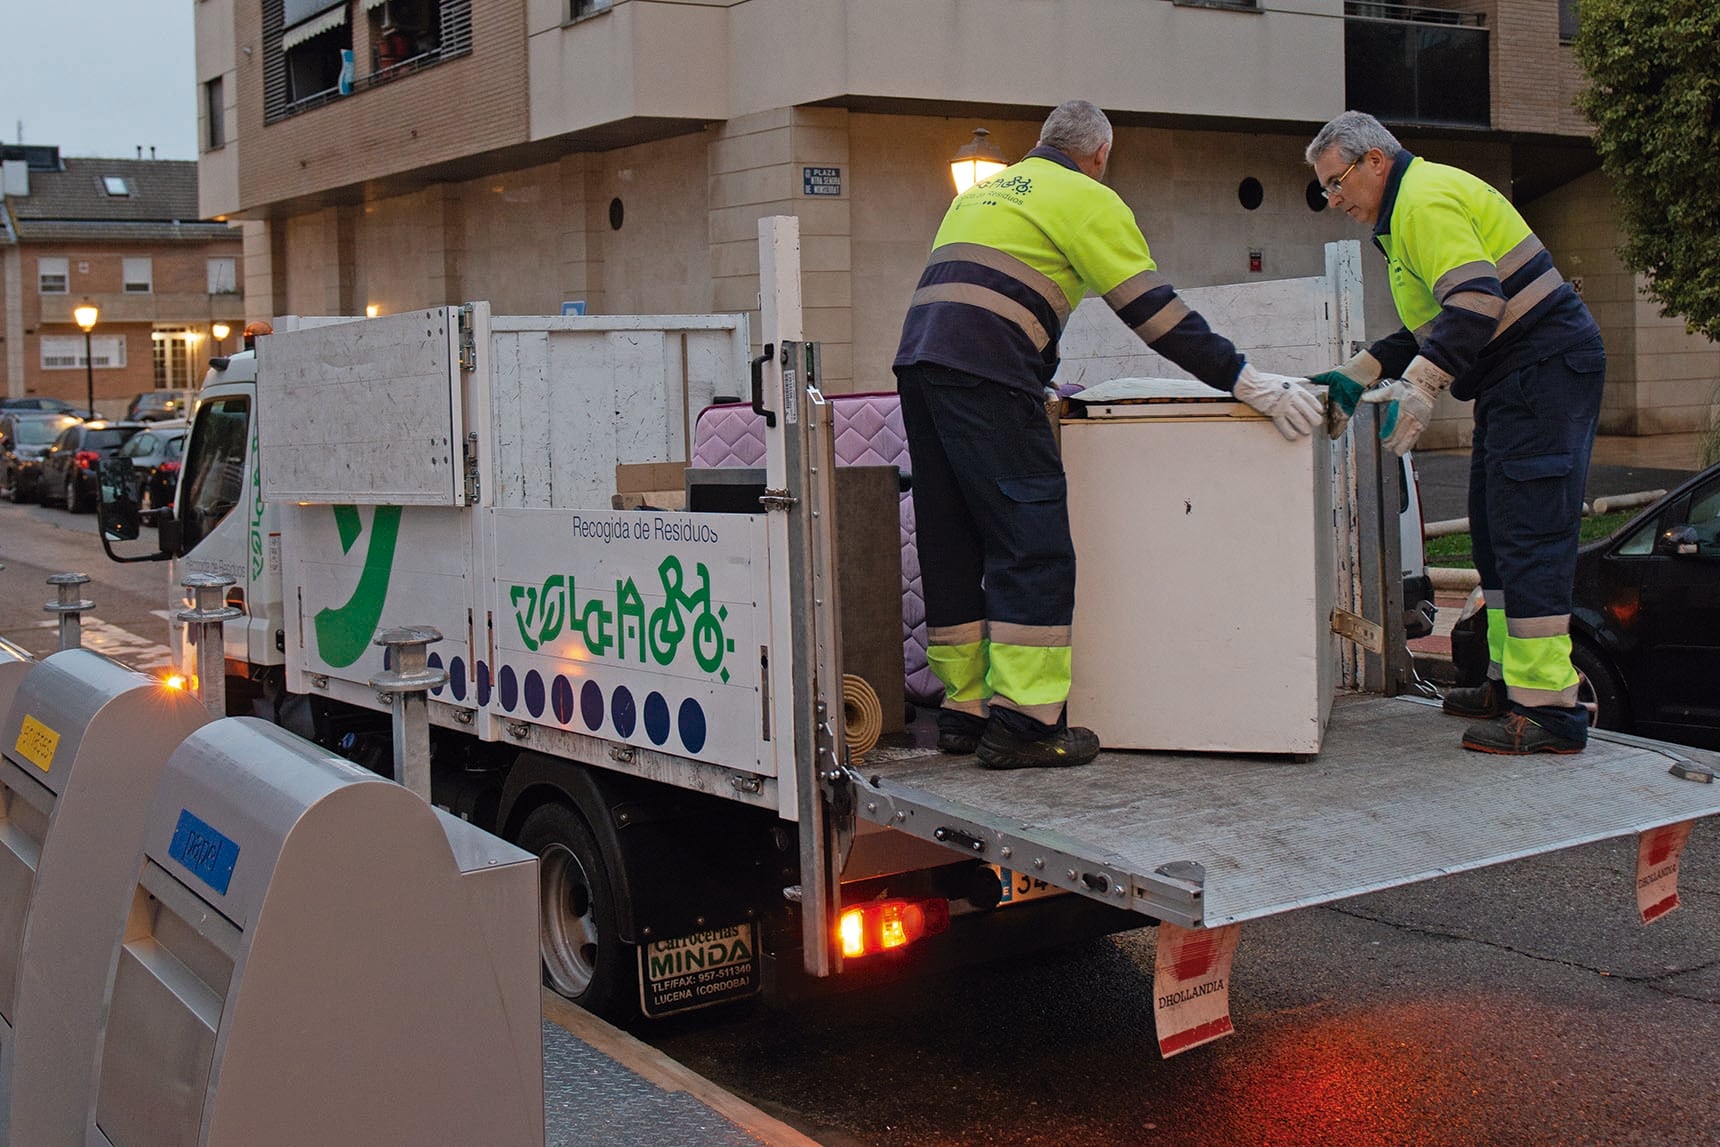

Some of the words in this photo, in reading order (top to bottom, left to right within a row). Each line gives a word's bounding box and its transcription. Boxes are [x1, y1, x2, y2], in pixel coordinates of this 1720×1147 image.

[813, 168, 836, 176] PLAZA
[573, 515, 630, 545] Recogida
[633, 519, 650, 540] de
[654, 516, 719, 544] Residuos
[650, 939, 753, 979] MINDA
[654, 989, 693, 1006] LUCENA
[1158, 978, 1225, 1010] DHOLLANDIA
